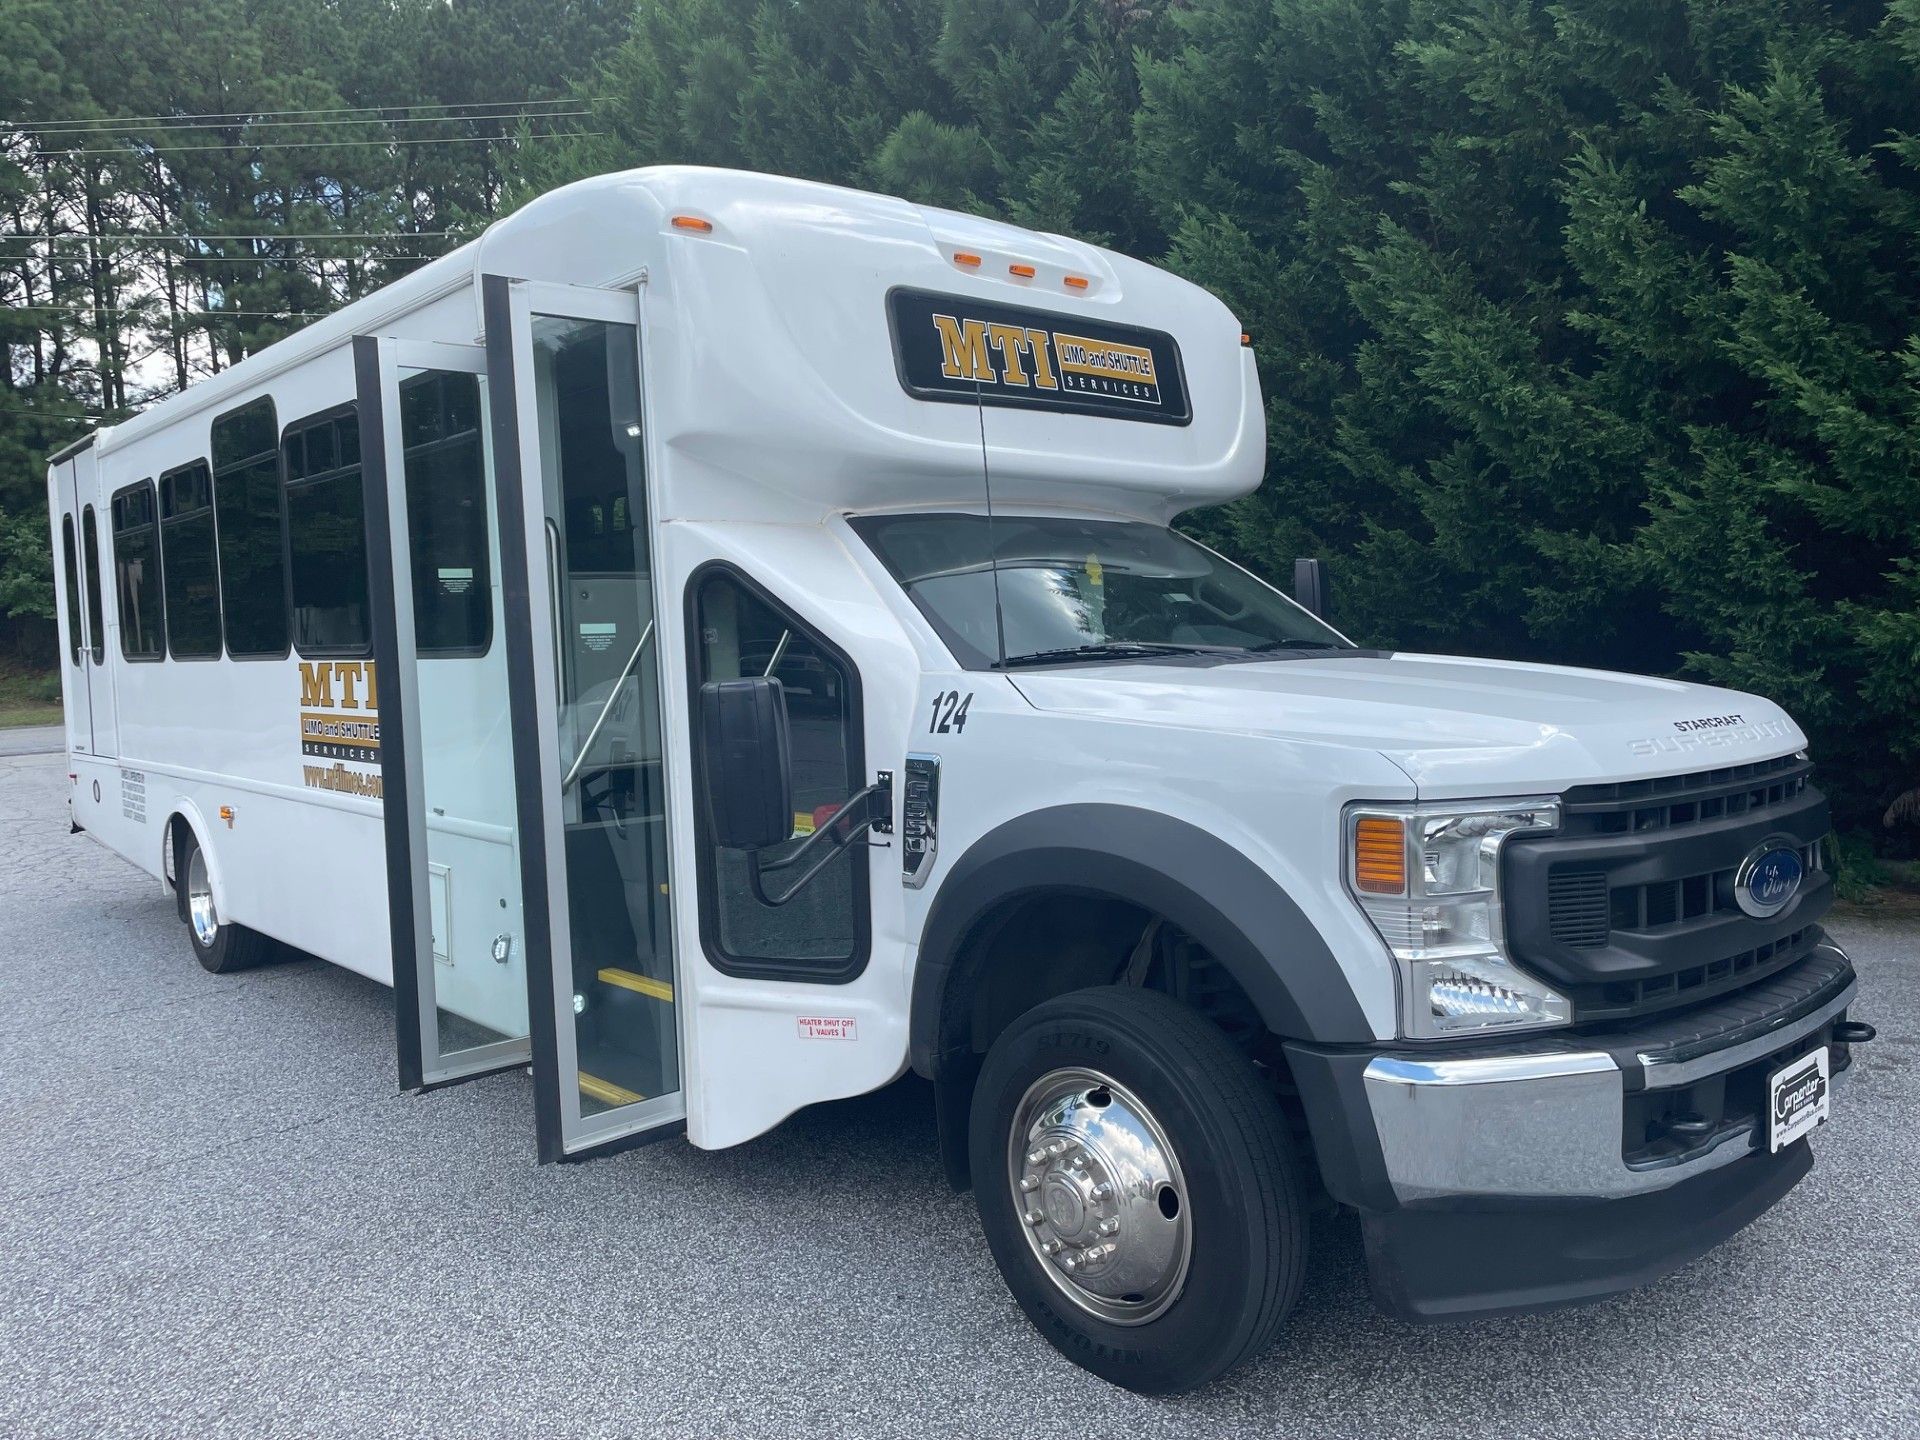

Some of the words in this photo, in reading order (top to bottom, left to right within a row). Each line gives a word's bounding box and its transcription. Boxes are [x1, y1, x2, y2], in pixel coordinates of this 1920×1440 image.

[932, 313, 1058, 390] MTI
[1060, 343, 1087, 366] LIMO
[1088, 350, 1106, 369] and
[1107, 353, 1151, 376] SHUTTLE
[1067, 376, 1150, 398] SERVICES
[299, 662, 378, 709] MTI
[929, 689, 974, 734] 124
[303, 719, 323, 735] LIMO
[324, 722, 339, 737] and
[341, 722, 380, 741] SHUTTLE
[1673, 714, 1746, 732] STARCRAFT
[304, 743, 375, 761] SERVICES
[799, 1019, 822, 1027] HEATER
[824, 1019, 841, 1027] SHUT
[816, 1028, 839, 1036] VALVES
[1776, 1077, 1820, 1119] Carpenter
